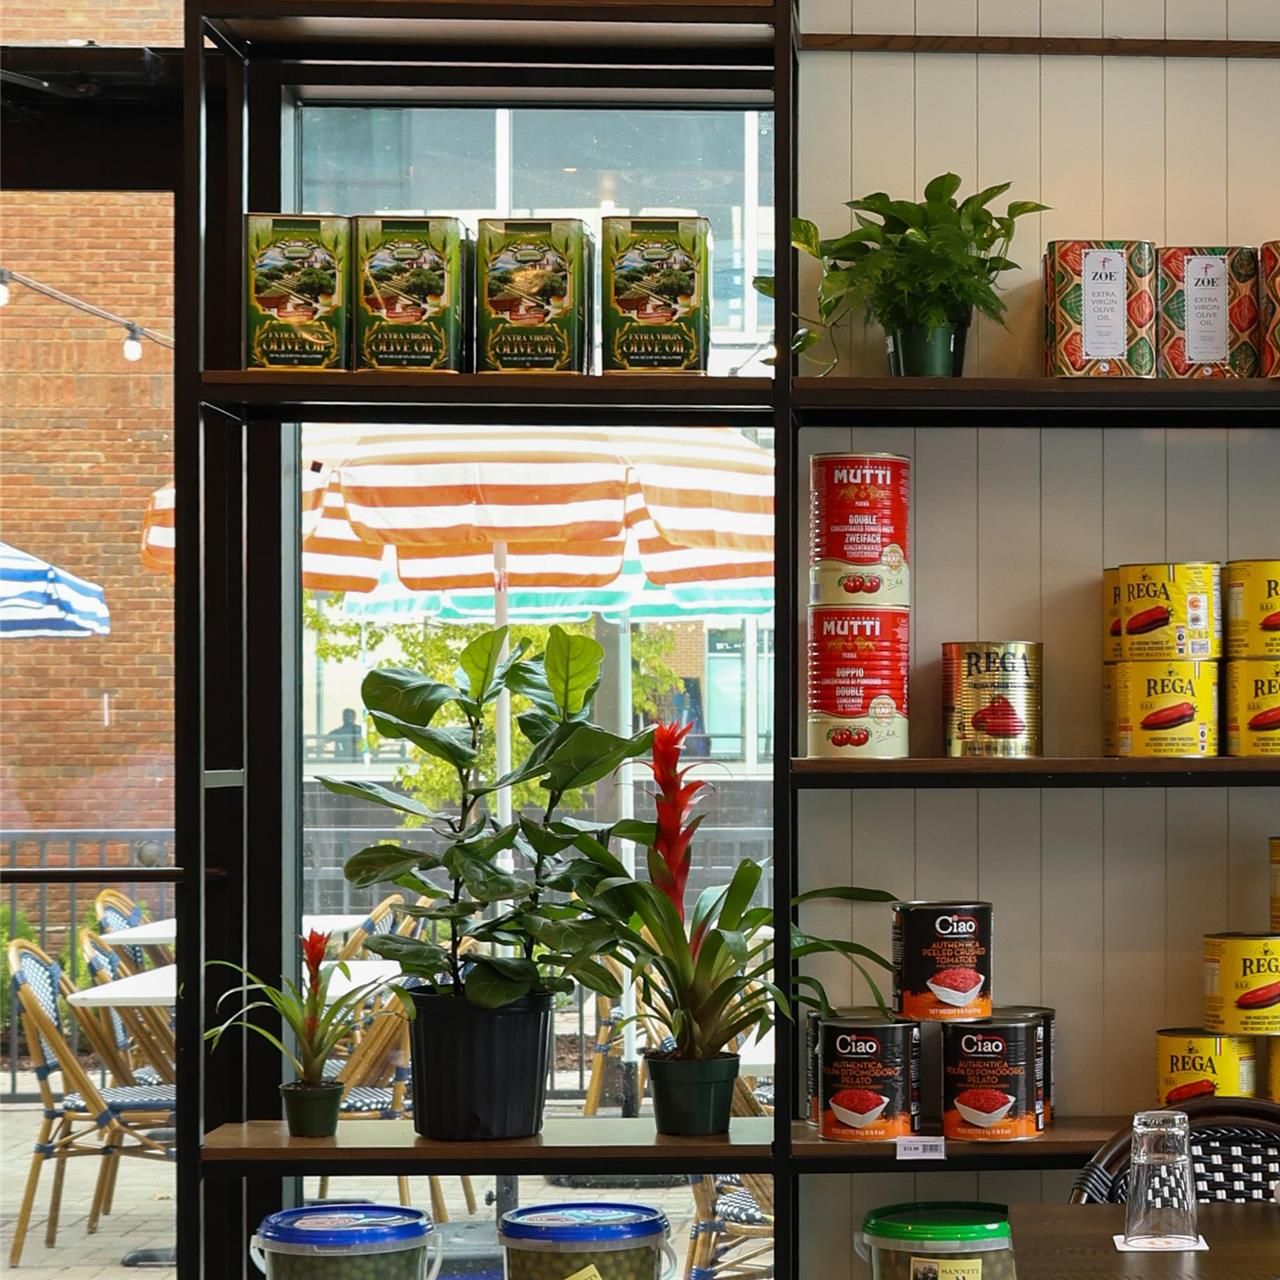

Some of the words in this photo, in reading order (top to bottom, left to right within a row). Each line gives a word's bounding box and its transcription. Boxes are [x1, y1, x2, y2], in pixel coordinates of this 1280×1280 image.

[1091, 271, 1117, 281] ZOE
[1194, 277, 1219, 287] ZOE
[262, 341, 303, 352] OLIVE
[305, 341, 328, 352] OIL
[371, 341, 412, 352] OLIVE
[414, 341, 435, 352] OIL
[495, 343, 535, 354] OLIVE
[537, 343, 558, 354] OIL
[622, 342, 663, 353] OLIVE
[665, 342, 687, 353] OIL
[834, 469, 891, 484] MUTTI
[849, 515, 877, 524] DOUBLE
[845, 533, 881, 543] ZWEIFACH
[1127, 583, 1171, 602] REGA
[823, 621, 881, 636] MUTTI
[965, 651, 1031, 678] REGA
[836, 668, 864, 677] DOPPIO
[836, 687, 864, 696] DOUBLE
[1146, 678, 1196, 698] REGA
[935, 914, 976, 934] Ciao
[936, 956, 977, 964] TOMATOES
[836, 1034, 877, 1054] Ciao
[961, 1034, 1003, 1053] Ciao
[1169, 1055, 1217, 1075] REGA
[976, 1067, 1025, 1076] POMODORO
[968, 1076, 999, 1084] PELATO
